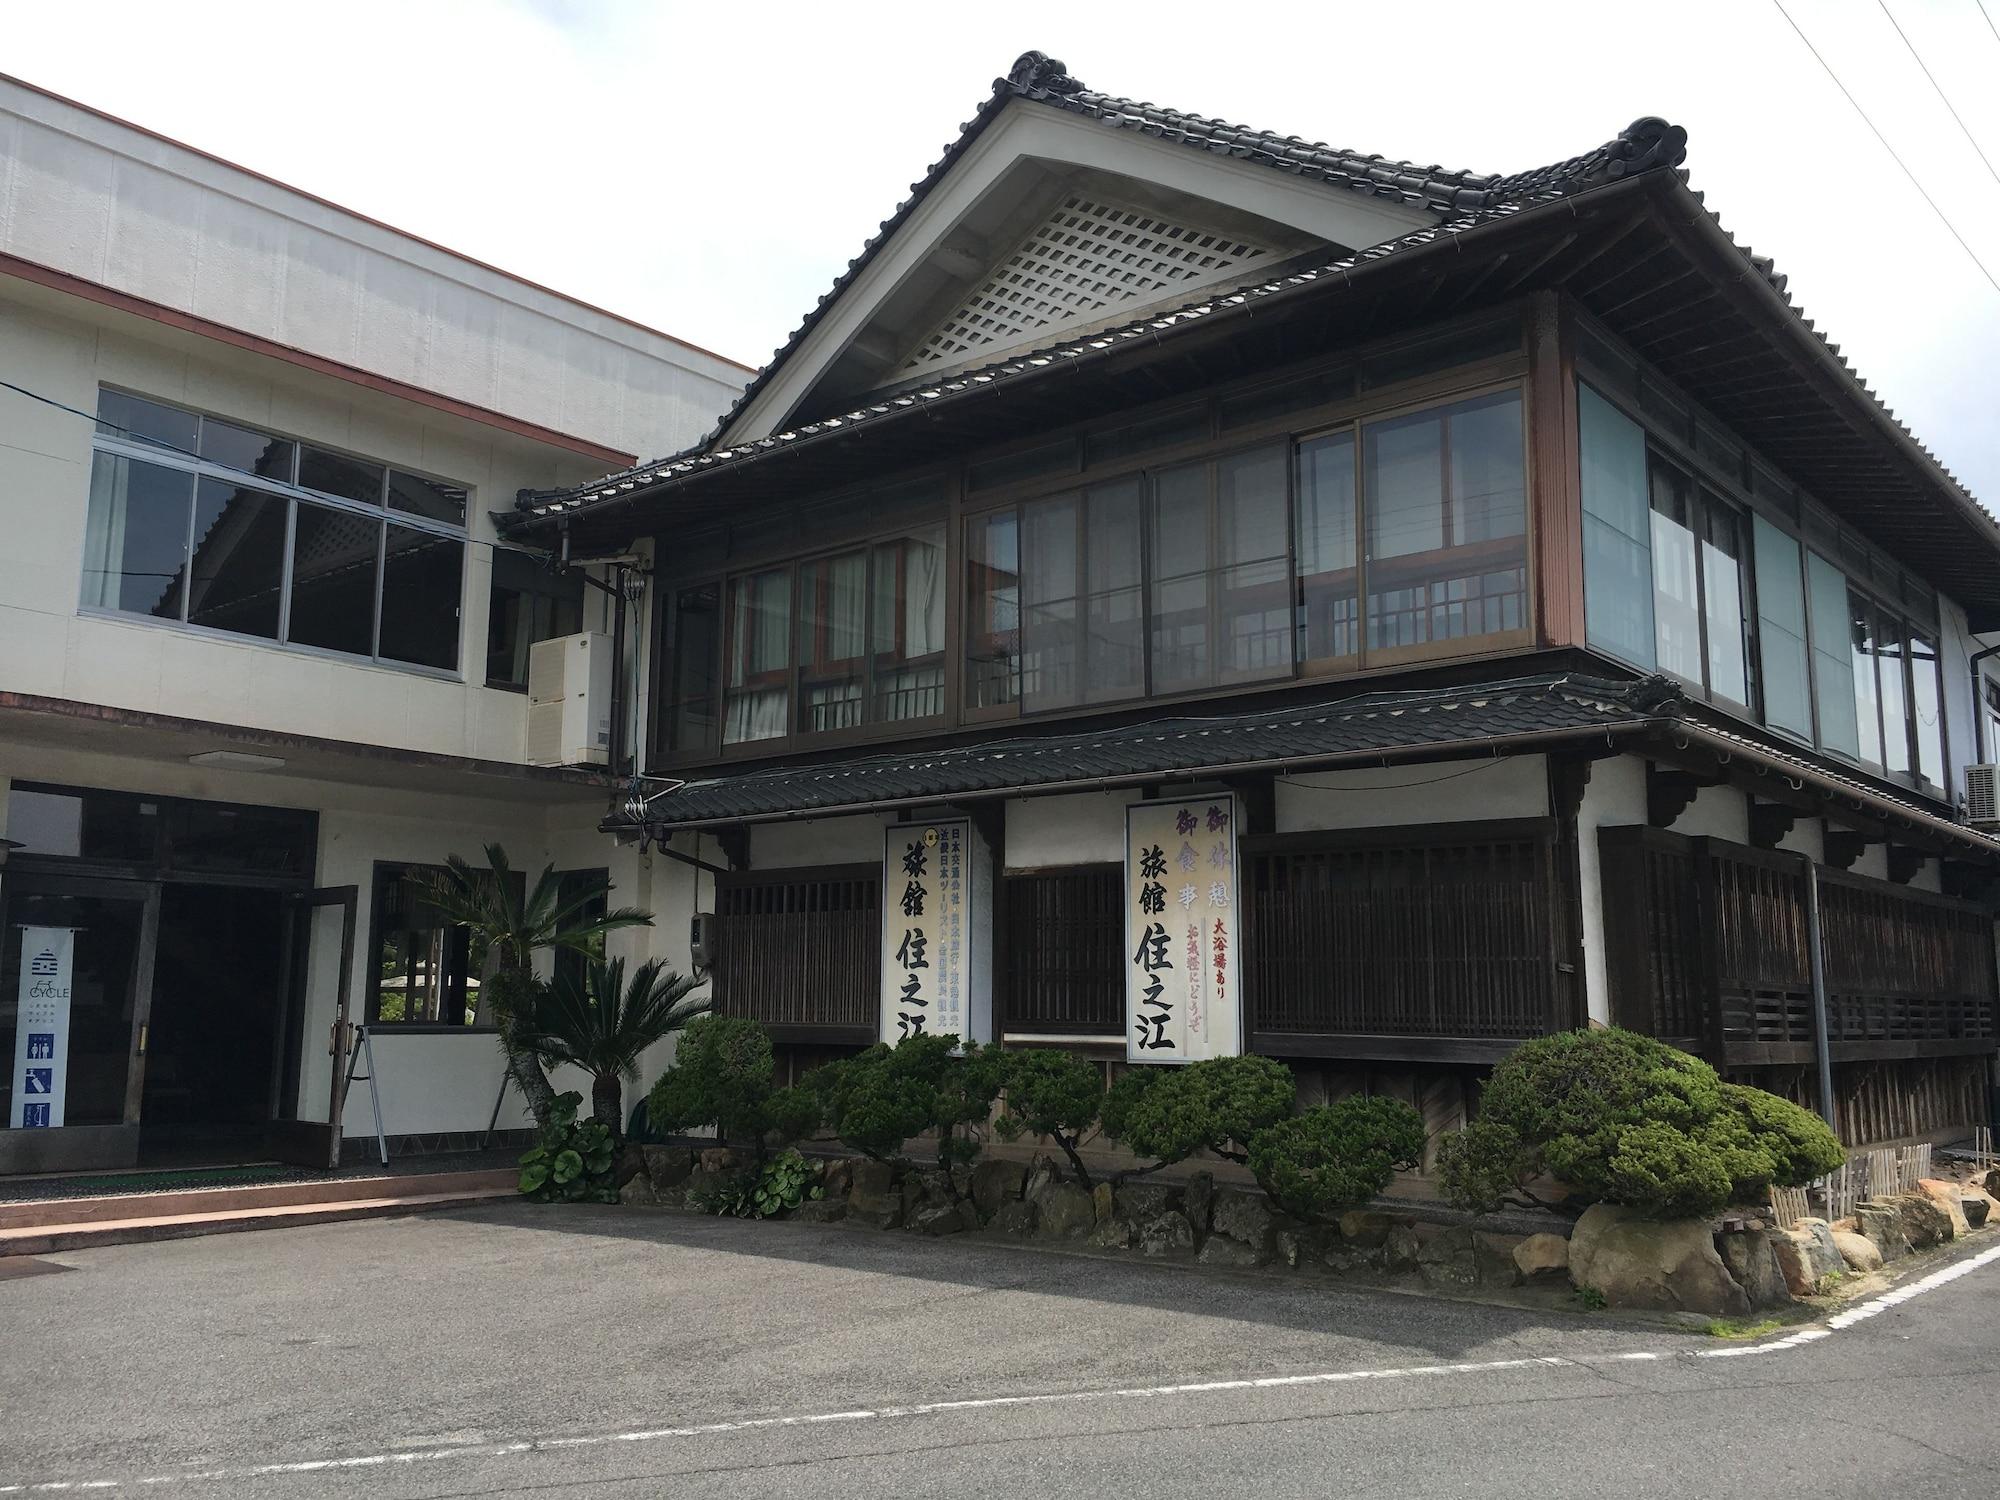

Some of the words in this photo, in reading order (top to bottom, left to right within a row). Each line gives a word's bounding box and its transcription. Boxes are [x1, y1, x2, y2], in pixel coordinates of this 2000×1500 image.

[1175, 808, 1200, 910] 御食事
[30, 988, 69, 998] CYCLE
[1186, 923, 1202, 1033] お気軽にどうぞ
[1213, 917, 1228, 999] 大浴場あり
